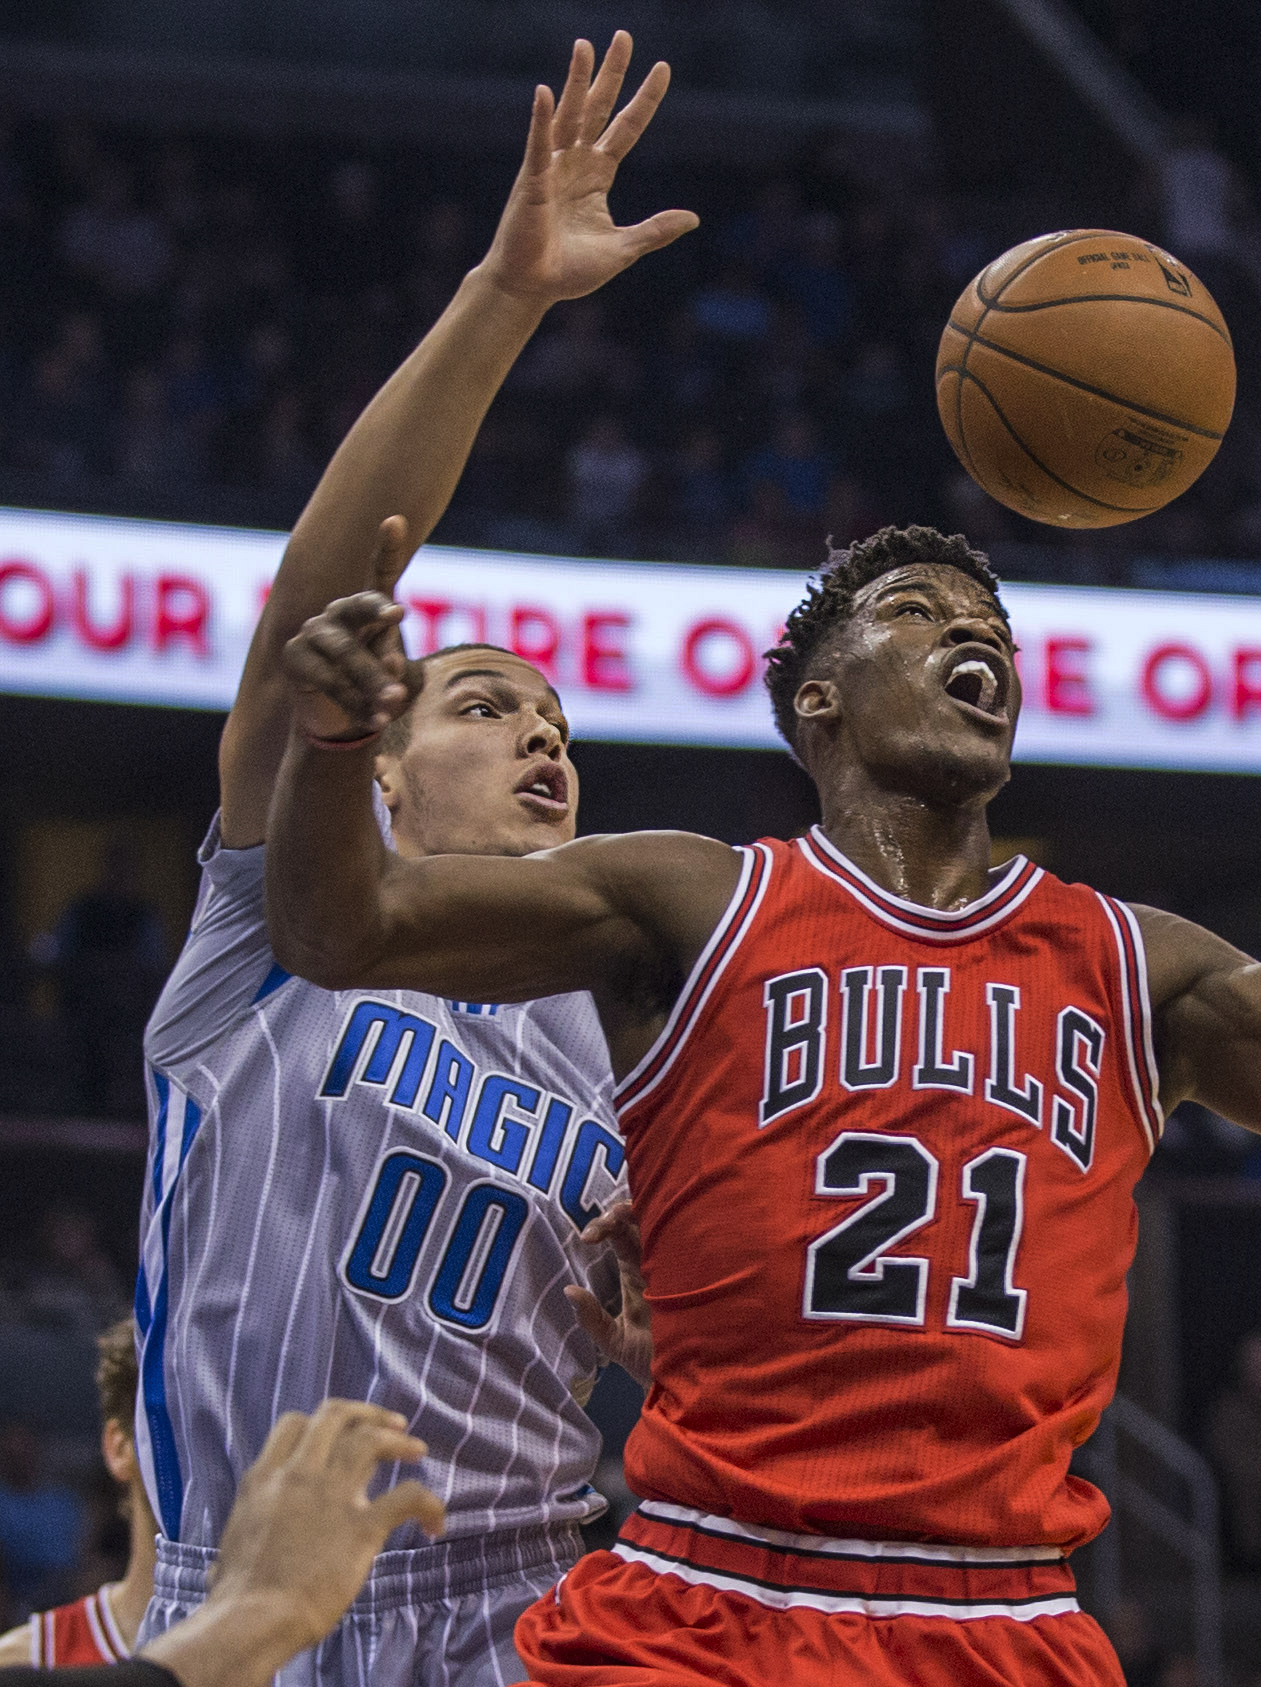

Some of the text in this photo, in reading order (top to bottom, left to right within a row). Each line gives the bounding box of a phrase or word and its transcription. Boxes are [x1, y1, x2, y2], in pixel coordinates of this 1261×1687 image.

[316, 995, 629, 1238] MAGIC
[758, 965, 1106, 1174] BULLS
[337, 1146, 534, 1334] 00
[802, 1131, 1028, 1341] 21
